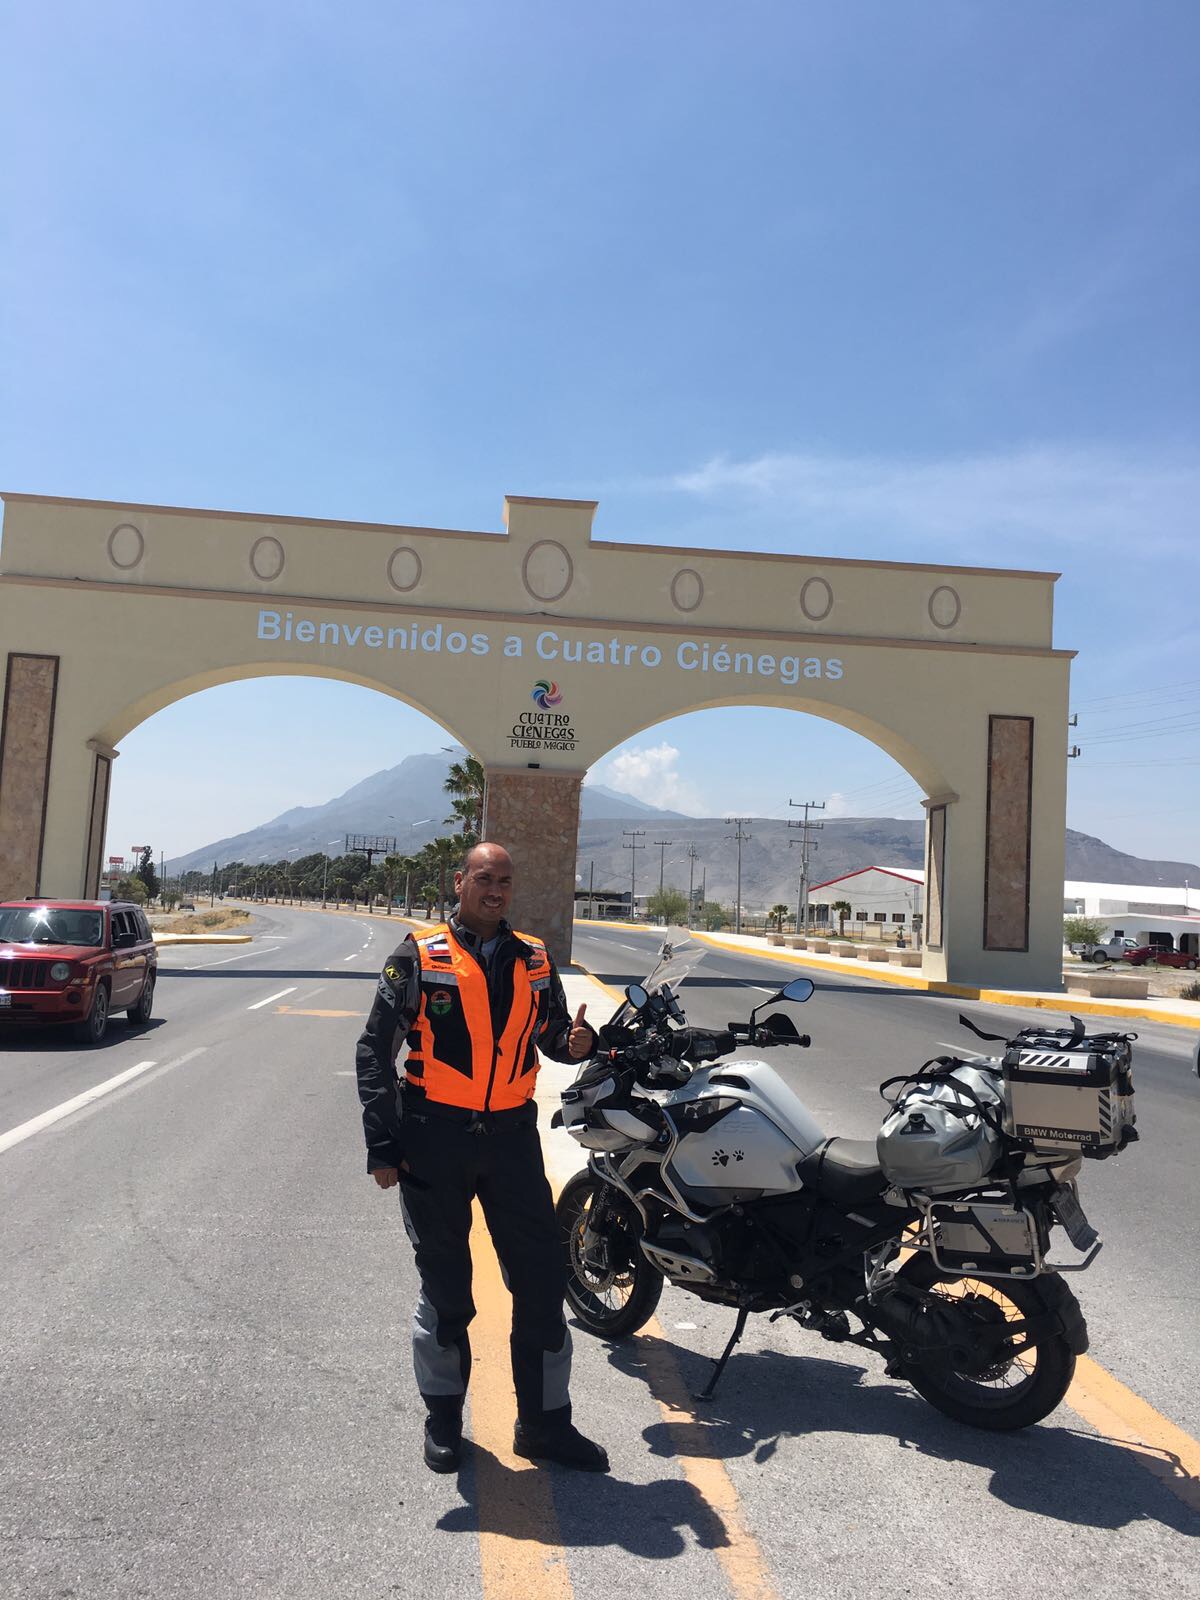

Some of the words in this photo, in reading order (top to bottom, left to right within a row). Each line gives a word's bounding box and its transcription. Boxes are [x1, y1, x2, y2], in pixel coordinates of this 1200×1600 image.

[256, 609, 491, 656] Bienvenidos
[503, 635, 524, 657] a
[535, 631, 662, 668] Cuatro
[676, 641, 844, 685] Ciénegas
[1024, 1127, 1047, 1137] BMW
[1050, 1130, 1092, 1141] Motorrad
